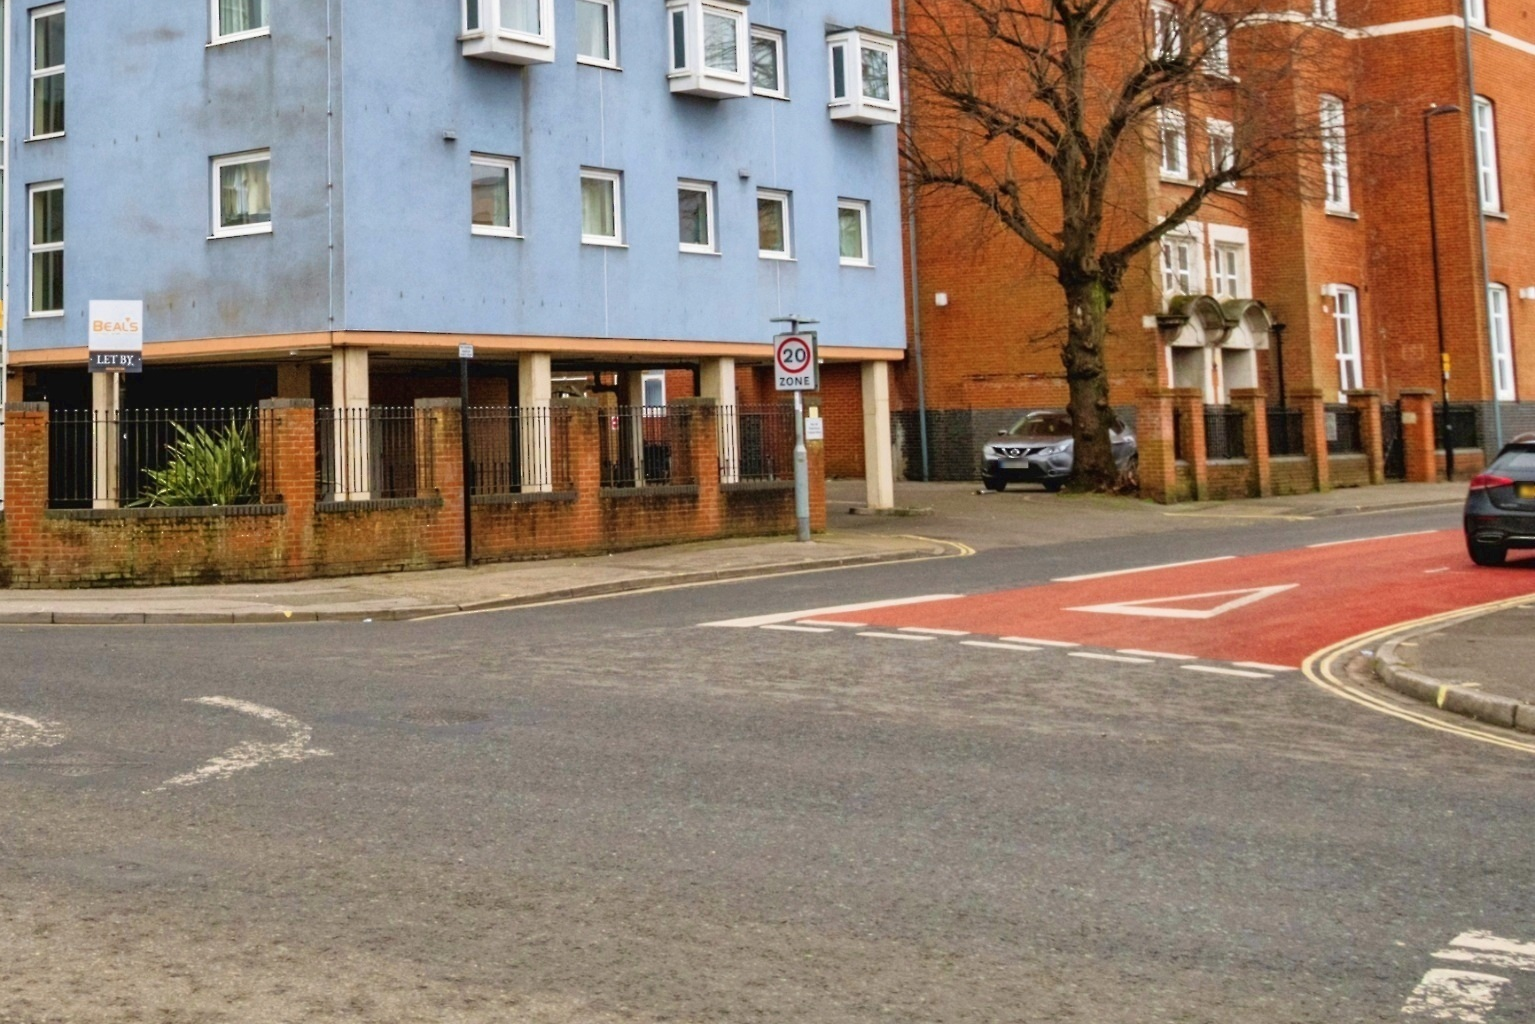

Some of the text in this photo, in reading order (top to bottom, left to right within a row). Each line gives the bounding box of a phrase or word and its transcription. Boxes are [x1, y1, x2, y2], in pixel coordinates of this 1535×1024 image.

[97, 355, 118, 364] LET
[783, 348, 806, 363] 20
[779, 376, 810, 386] ZONE
